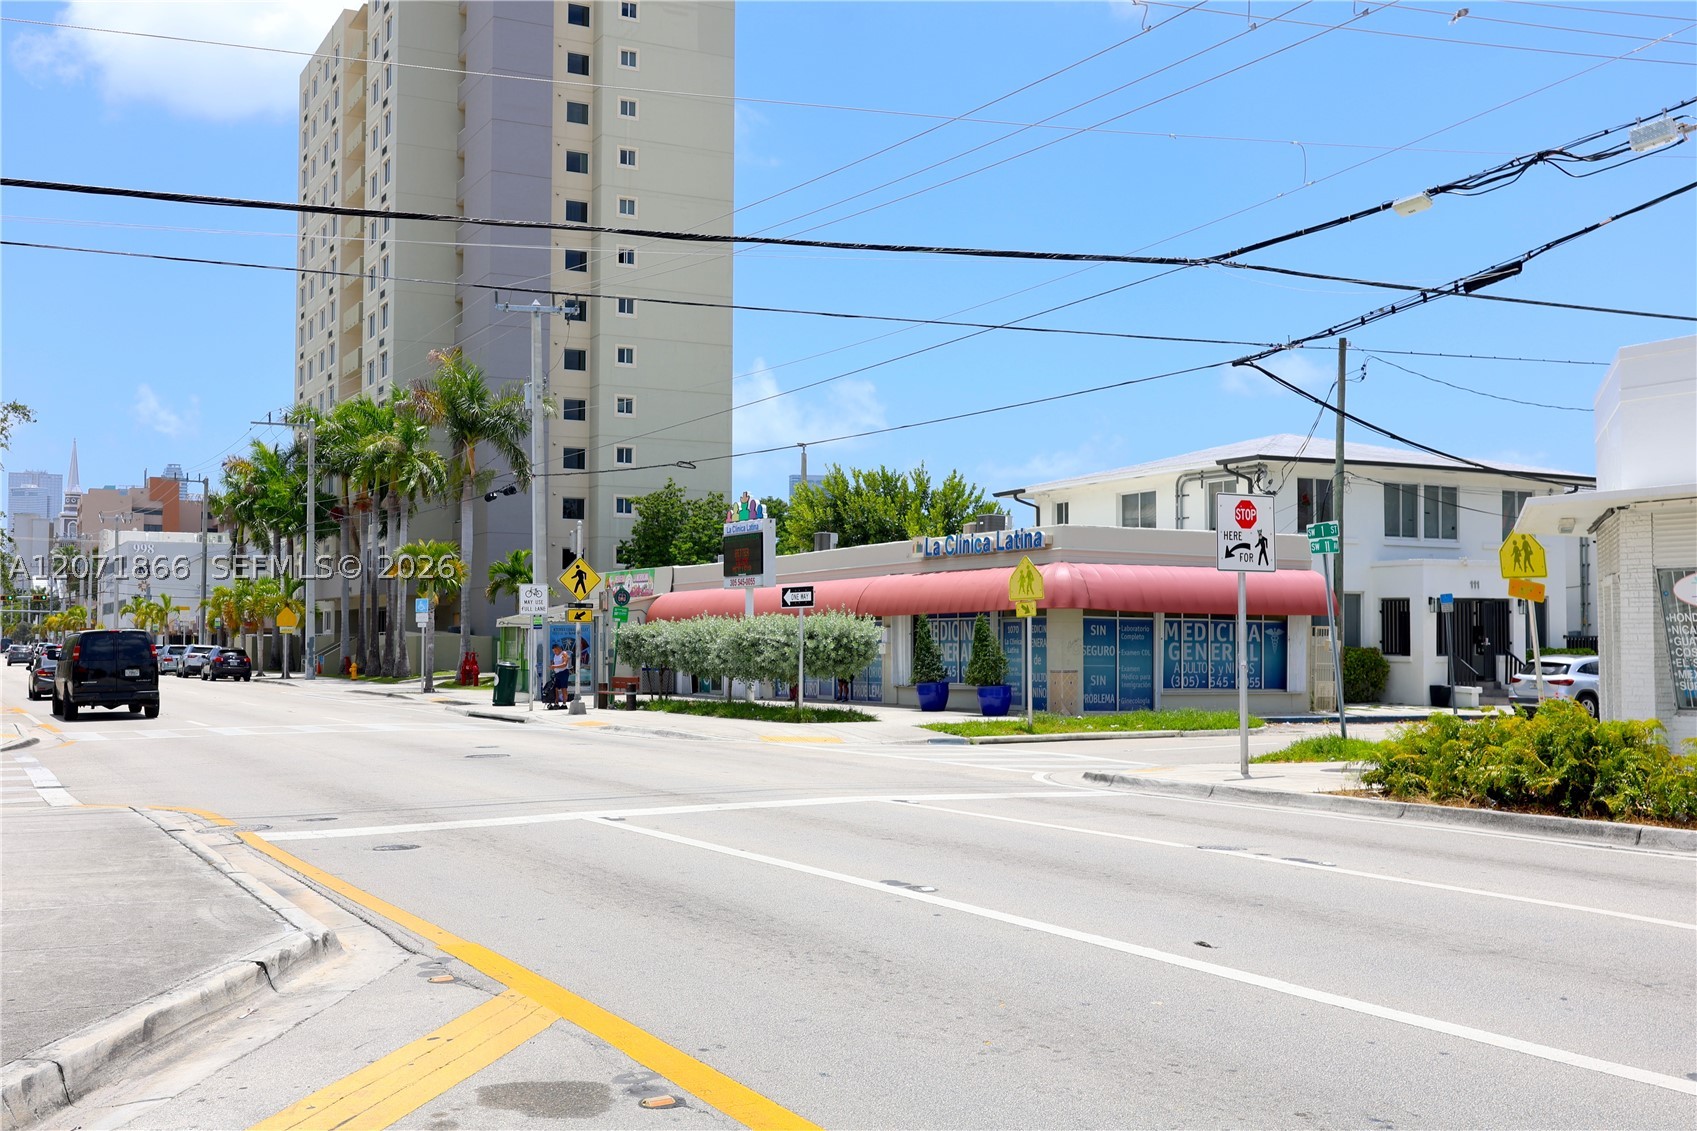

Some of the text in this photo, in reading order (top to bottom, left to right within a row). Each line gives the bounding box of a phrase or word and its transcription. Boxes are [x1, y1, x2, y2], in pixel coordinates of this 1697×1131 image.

[1235, 508, 1256, 520] STOP
[1223, 530, 1243, 542] HERE
[1308, 525, 1338, 537] SW 1 ST
[925, 537, 941, 557] La
[996, 527, 1043, 551] Latina
[1311, 542, 1320, 552] SW
[1324, 540, 1331, 552] 11
[133, 543, 155, 555] 998
[1239, 552, 1254, 563] FOR
[1469, 580, 1480, 590] 111
[791, 592, 810, 601] ONE WAY
[929, 620, 977, 641] EDICIN
[1007, 625, 1020, 634] 1070
[1090, 624, 1107, 636] SIN
[1120, 624, 1150, 633] Laboratorio
[1164, 622, 1261, 642] MEDICIA
[1120, 633, 1145, 641] Completo
[1082, 644, 1116, 657] SEGURO
[1120, 649, 1151, 657] Examen CDL
[1168, 642, 1258, 661] GENERL
[1033, 653, 1042, 666] de
[1120, 665, 1141, 673] Examen
[1173, 662, 1255, 676] ADULTOS y NIS
[1090, 675, 1107, 686] SIN
[1139, 674, 1151, 683] para
[1170, 674, 1200, 689] (305)
[1210, 676, 1229, 689] 545
[1236, 676, 1261, 689] 55
[1083, 693, 1116, 704] ROBLEMA
